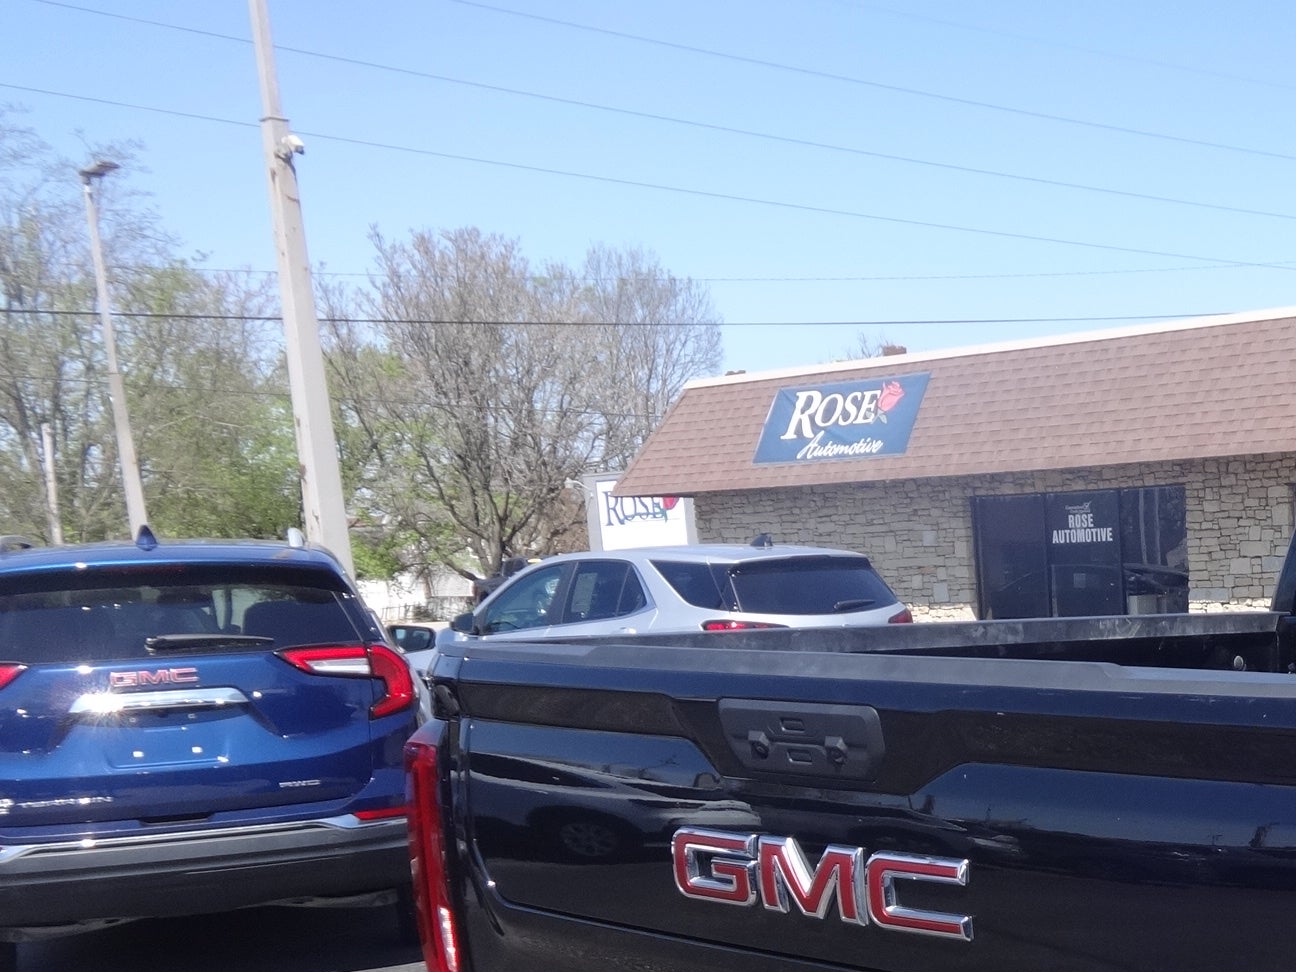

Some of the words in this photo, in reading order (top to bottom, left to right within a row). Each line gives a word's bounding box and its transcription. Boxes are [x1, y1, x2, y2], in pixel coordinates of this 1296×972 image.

[780, 390, 881, 440] ROSE
[796, 430, 883, 459] Automotive
[1068, 513, 1094, 528] ROSE
[1052, 527, 1113, 544] AUTOMOTIVE
[109, 667, 200, 688] GMC
[671, 826, 975, 942] GMC
